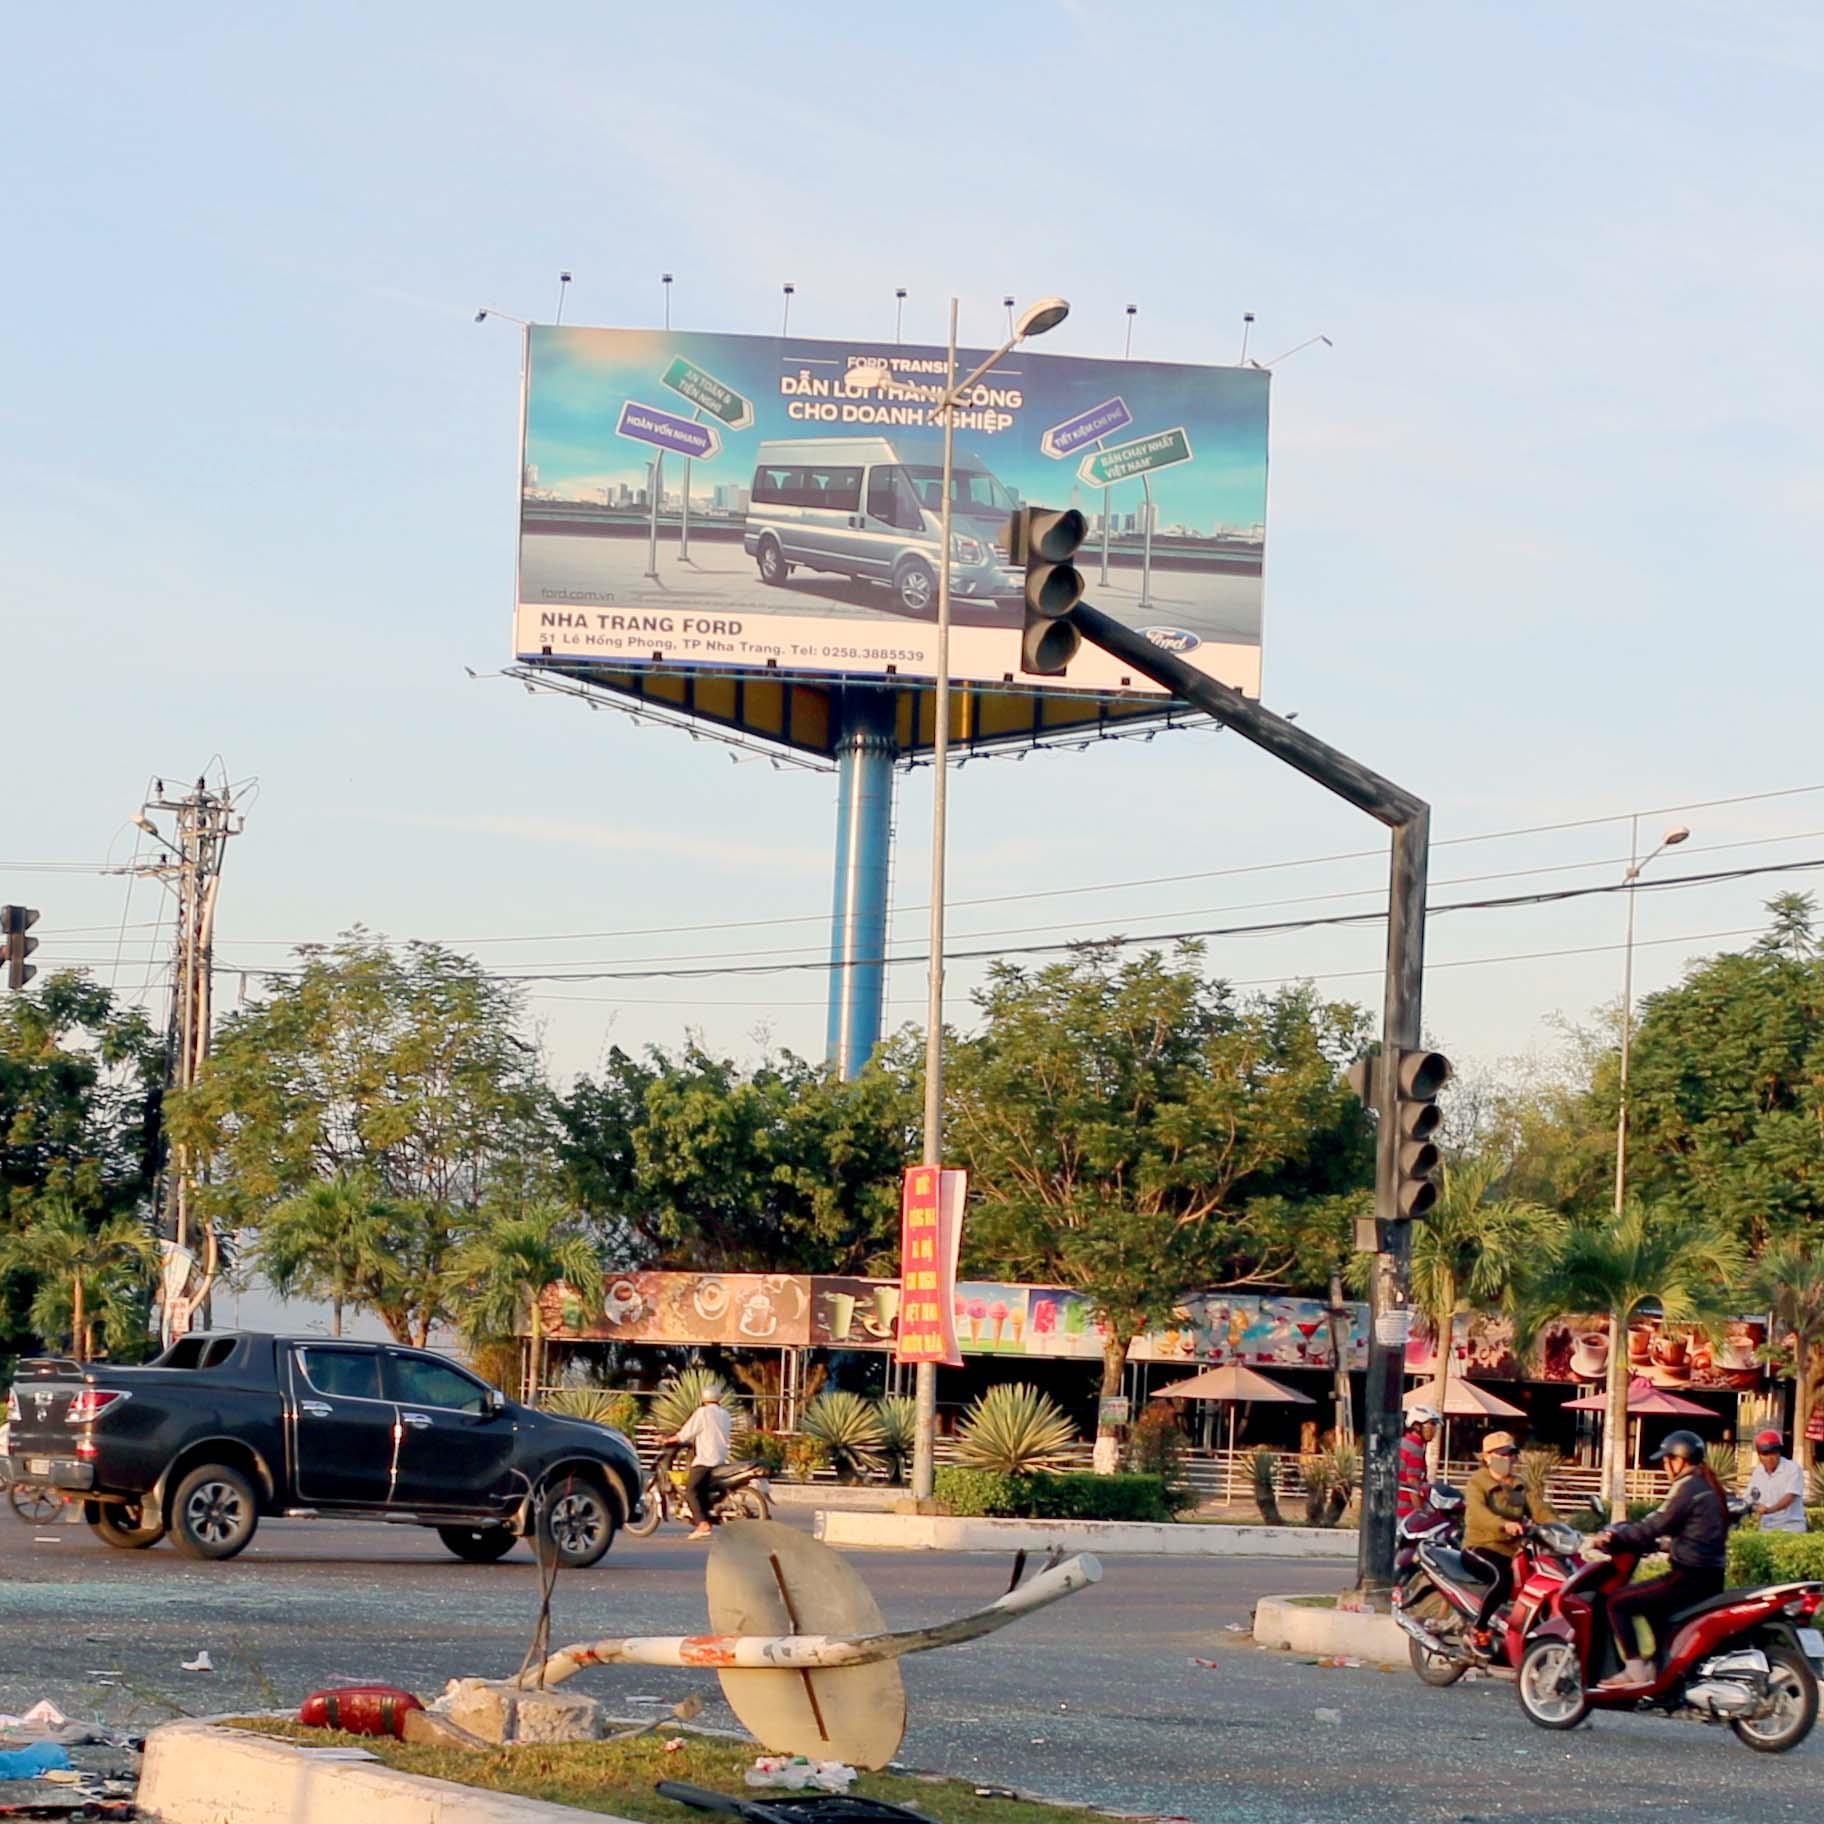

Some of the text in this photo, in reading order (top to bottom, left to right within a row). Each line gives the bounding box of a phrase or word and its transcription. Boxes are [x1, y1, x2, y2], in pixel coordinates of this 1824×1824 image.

[847, 356, 888, 370] FORD
[781, 370, 829, 396] DẪN
[788, 402, 838, 421] CHO
[842, 405, 924, 426] DOANH
[541, 587, 615, 601] ford.com.vn
[541, 612, 742, 636] NHA TRANG FORD
[539, 632, 556, 644] 51
[682, 639, 701, 650] TP
[706, 640, 734, 652] Nha
[790, 644, 818, 657] Tel:
